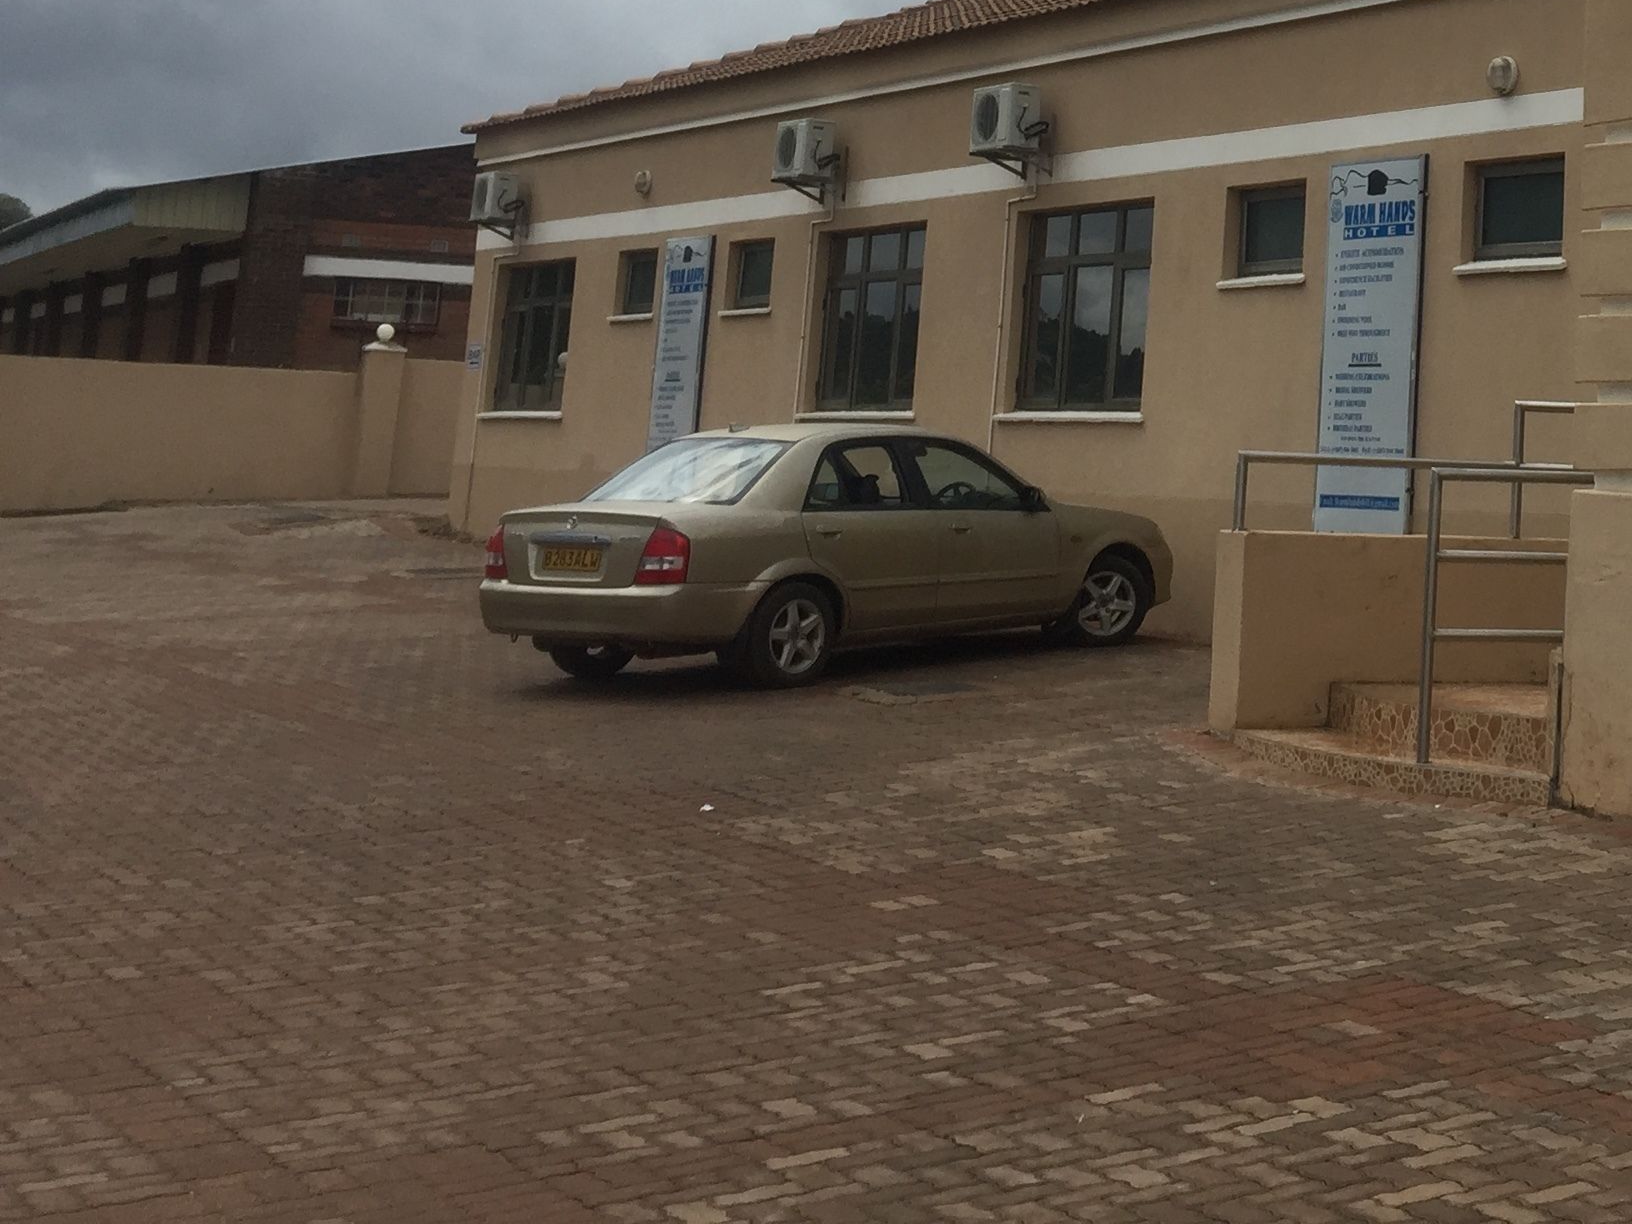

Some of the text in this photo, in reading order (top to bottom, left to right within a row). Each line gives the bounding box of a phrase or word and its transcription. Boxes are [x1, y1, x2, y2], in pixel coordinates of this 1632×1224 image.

[1345, 203, 1376, 226] WARM
[1379, 199, 1416, 223] HANDS
[1345, 225, 1415, 238] HOTEL
